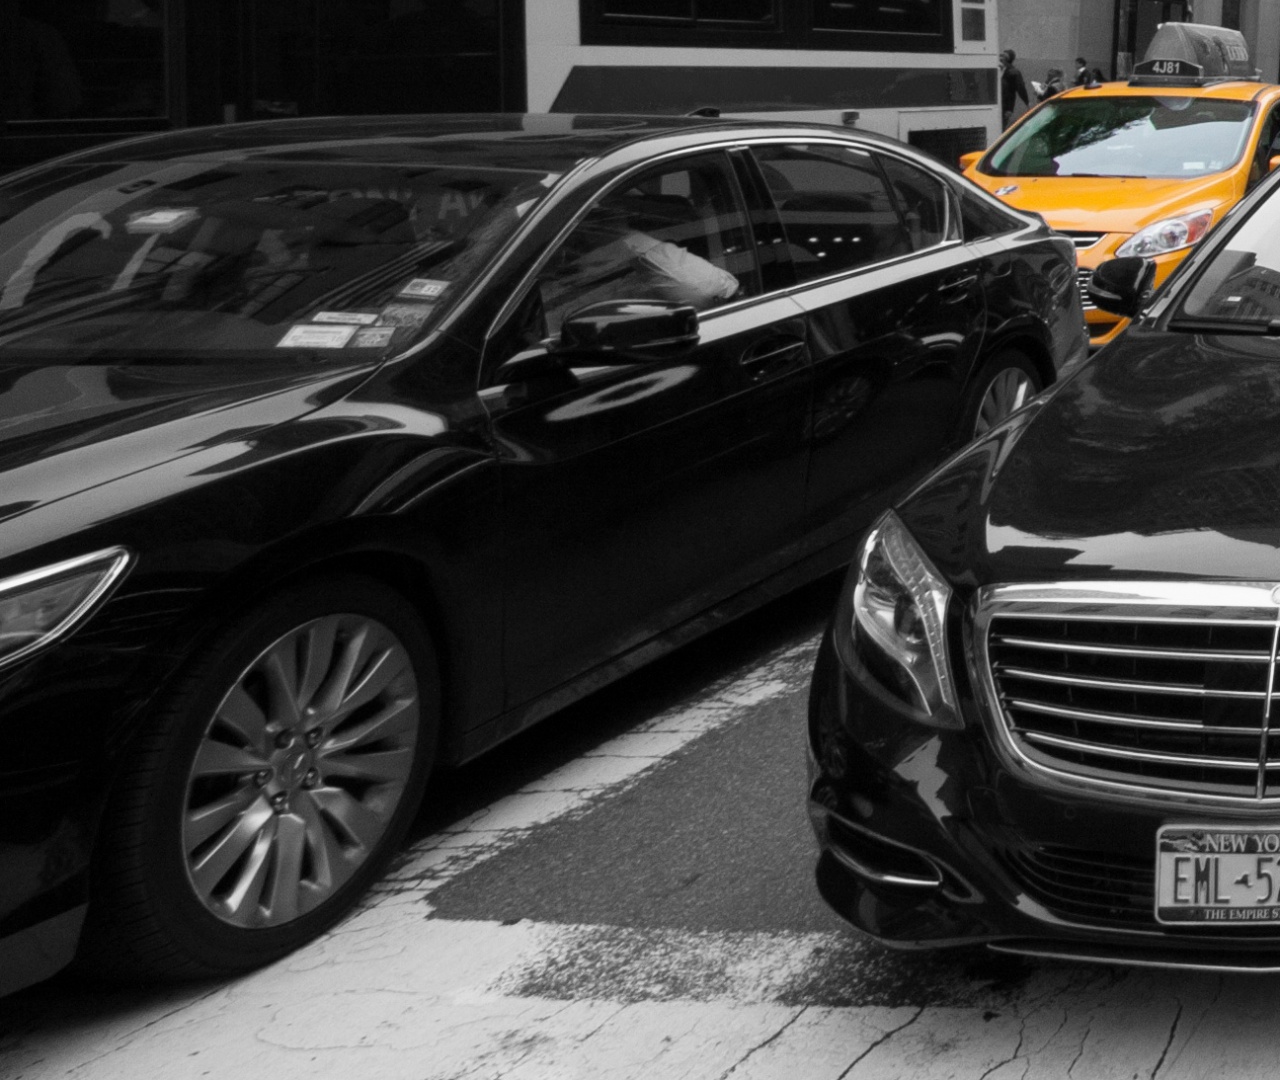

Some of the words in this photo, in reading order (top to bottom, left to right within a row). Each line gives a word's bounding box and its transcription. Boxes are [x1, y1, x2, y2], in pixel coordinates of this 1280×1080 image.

[1152, 61, 1180, 74] 4J81
[1205, 833, 1248, 853] NEW
[1173, 857, 1231, 904] EML
[1204, 908, 1227, 920] THE
[1229, 908, 1270, 920] EMPIRE
